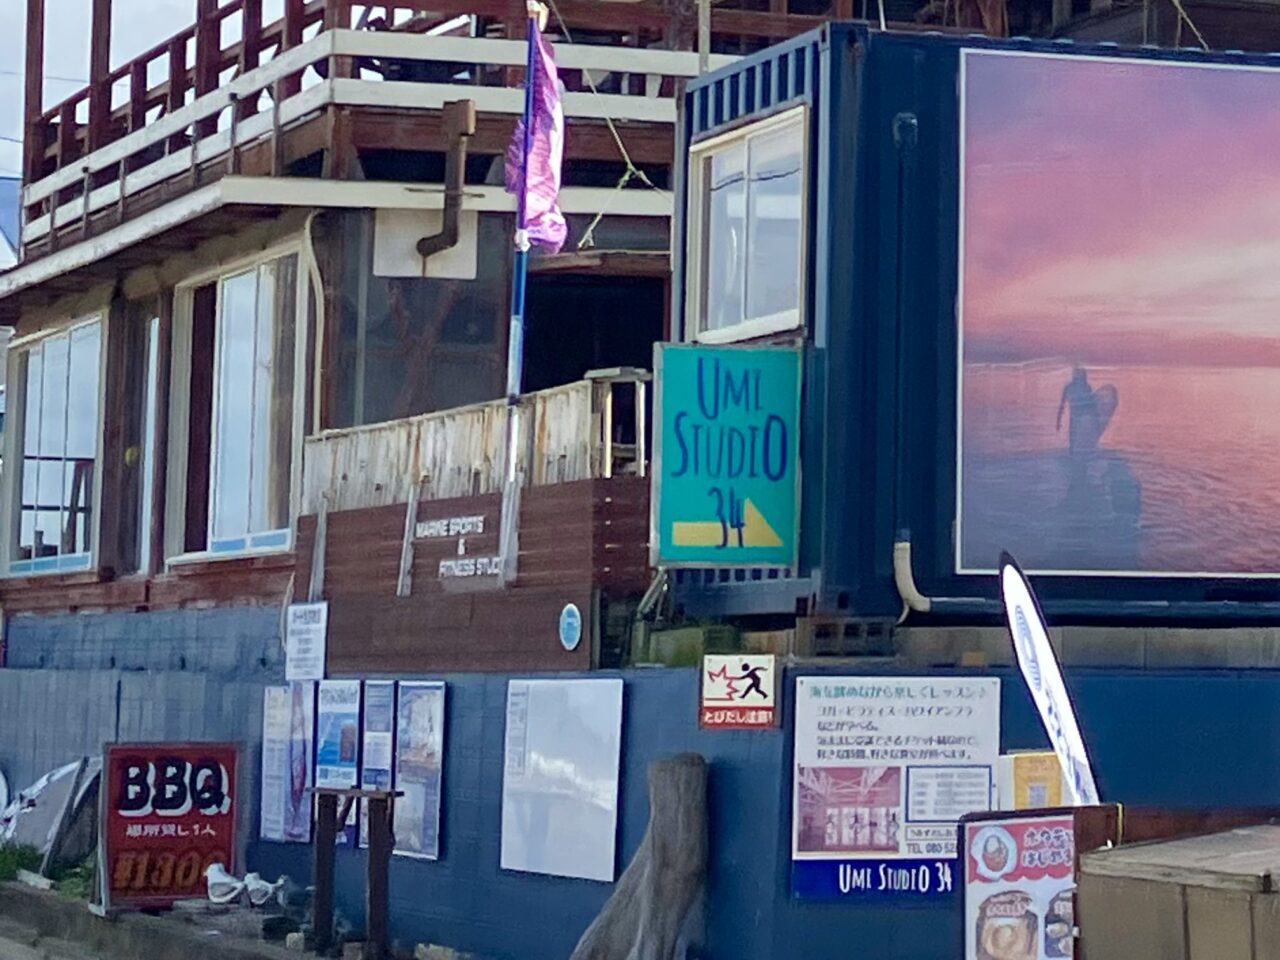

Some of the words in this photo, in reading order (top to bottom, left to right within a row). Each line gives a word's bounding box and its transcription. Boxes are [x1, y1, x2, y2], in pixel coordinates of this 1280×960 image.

[707, 486, 745, 550] 34
[117, 755, 232, 817] BBQ
[907, 843, 923, 855] TEL
[934, 861, 952, 892] 34
